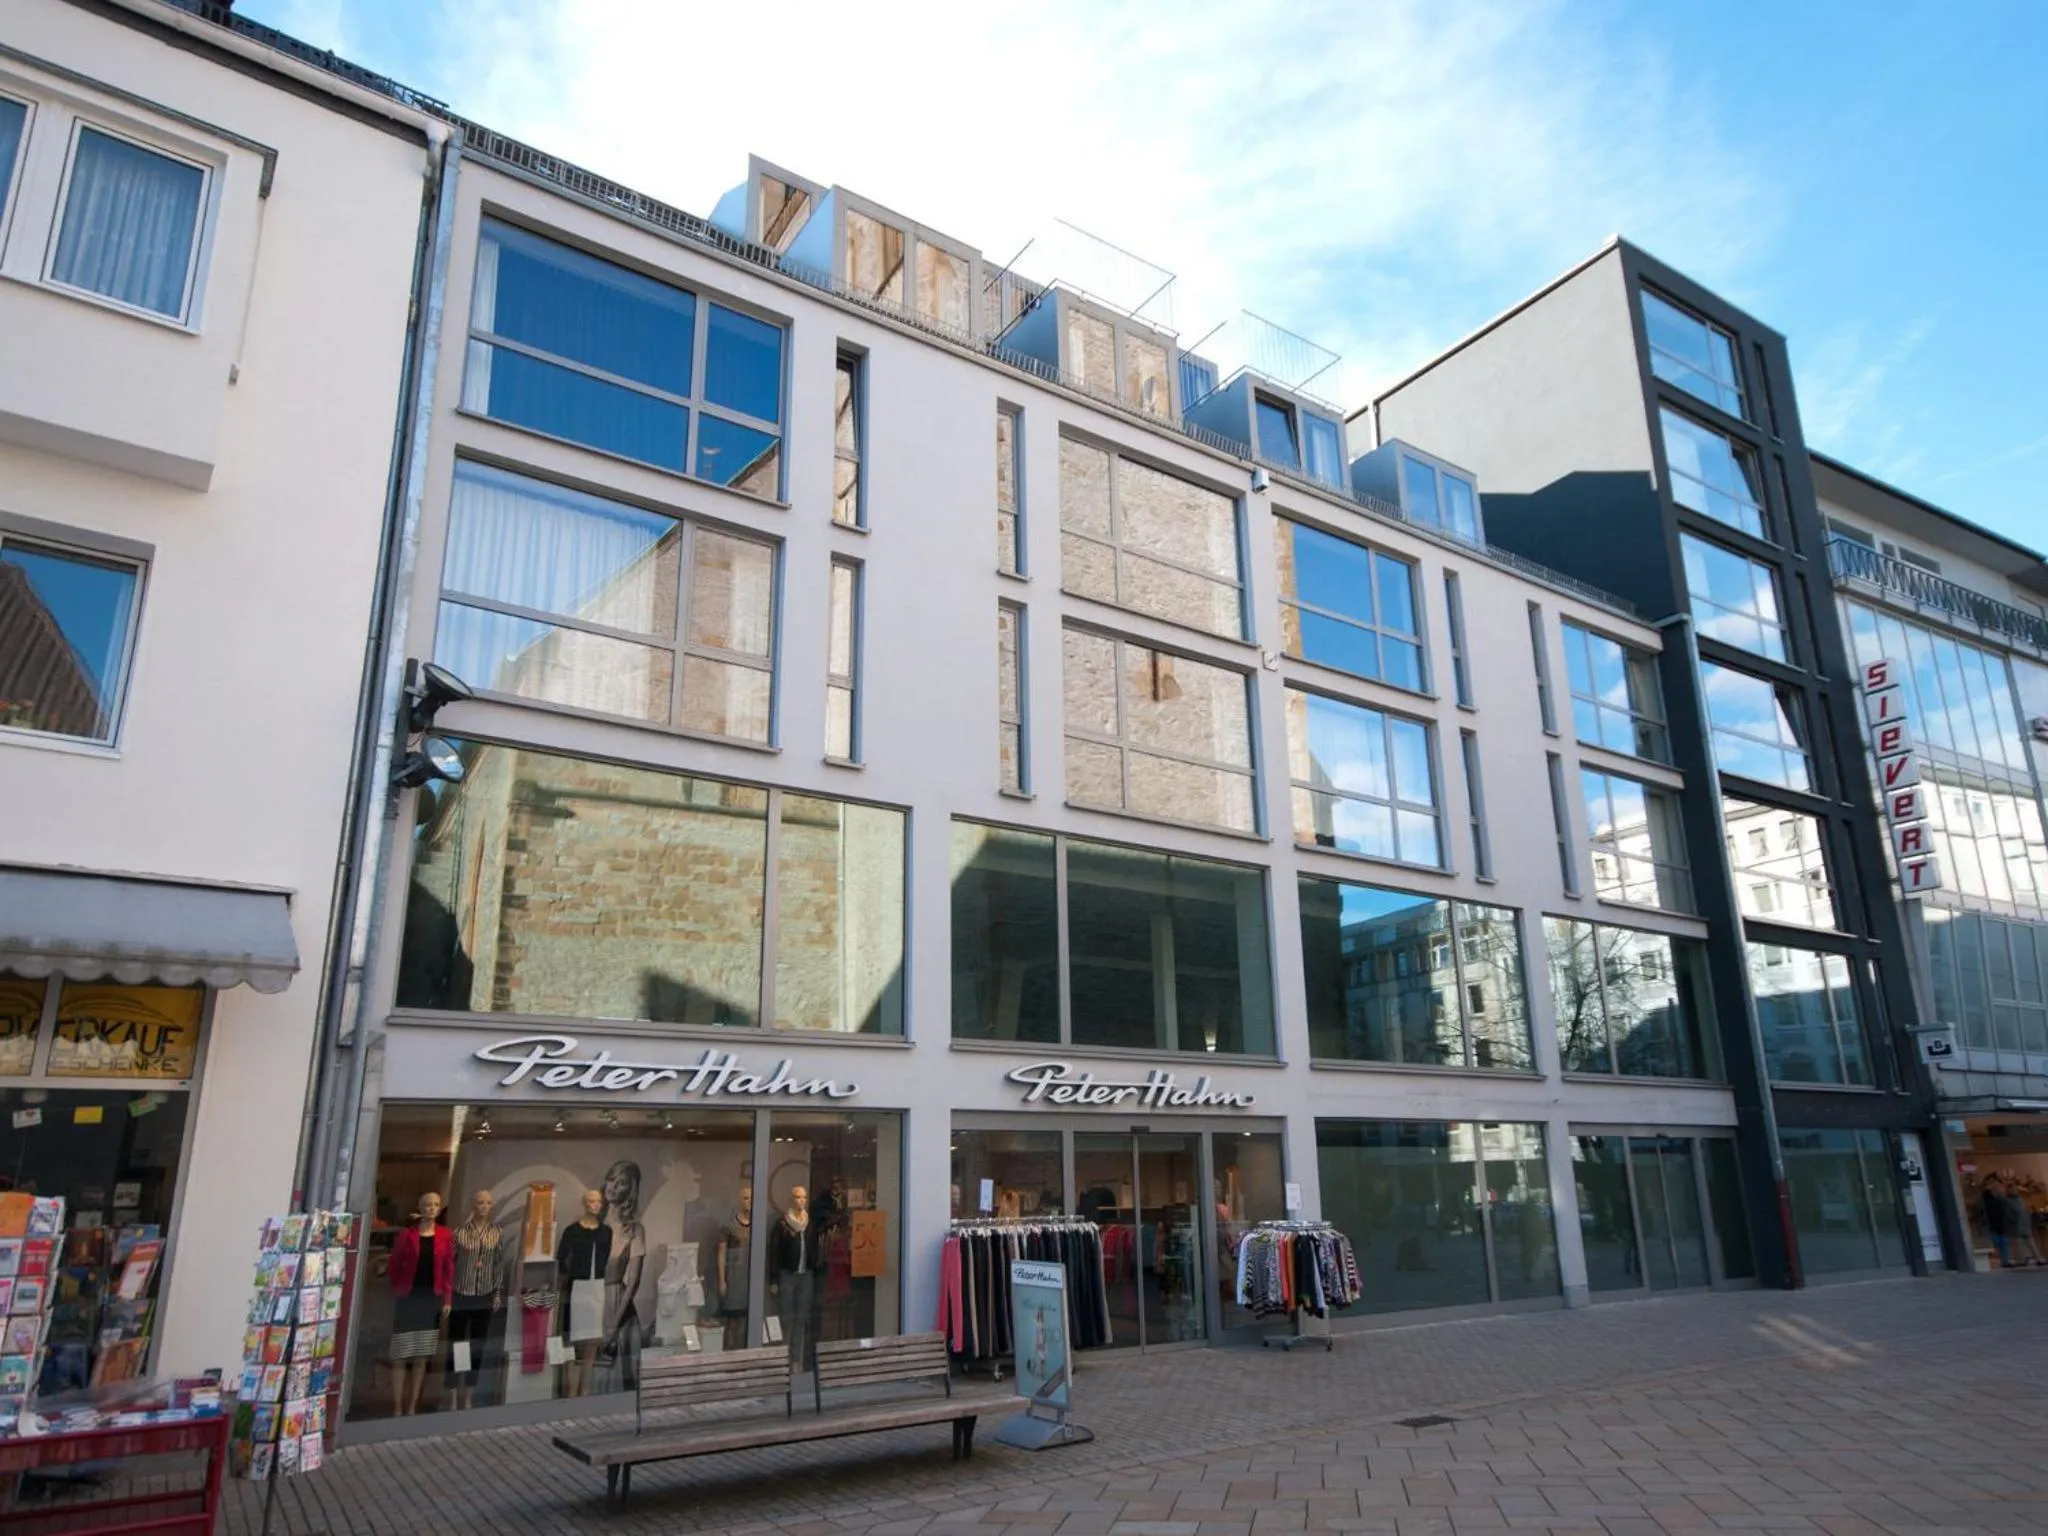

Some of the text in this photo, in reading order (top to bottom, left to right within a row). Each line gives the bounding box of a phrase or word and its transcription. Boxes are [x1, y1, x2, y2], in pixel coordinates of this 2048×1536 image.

[472, 1034, 861, 1098] Peter Hahn
[1004, 1061, 1257, 1108] Peter Hahn
